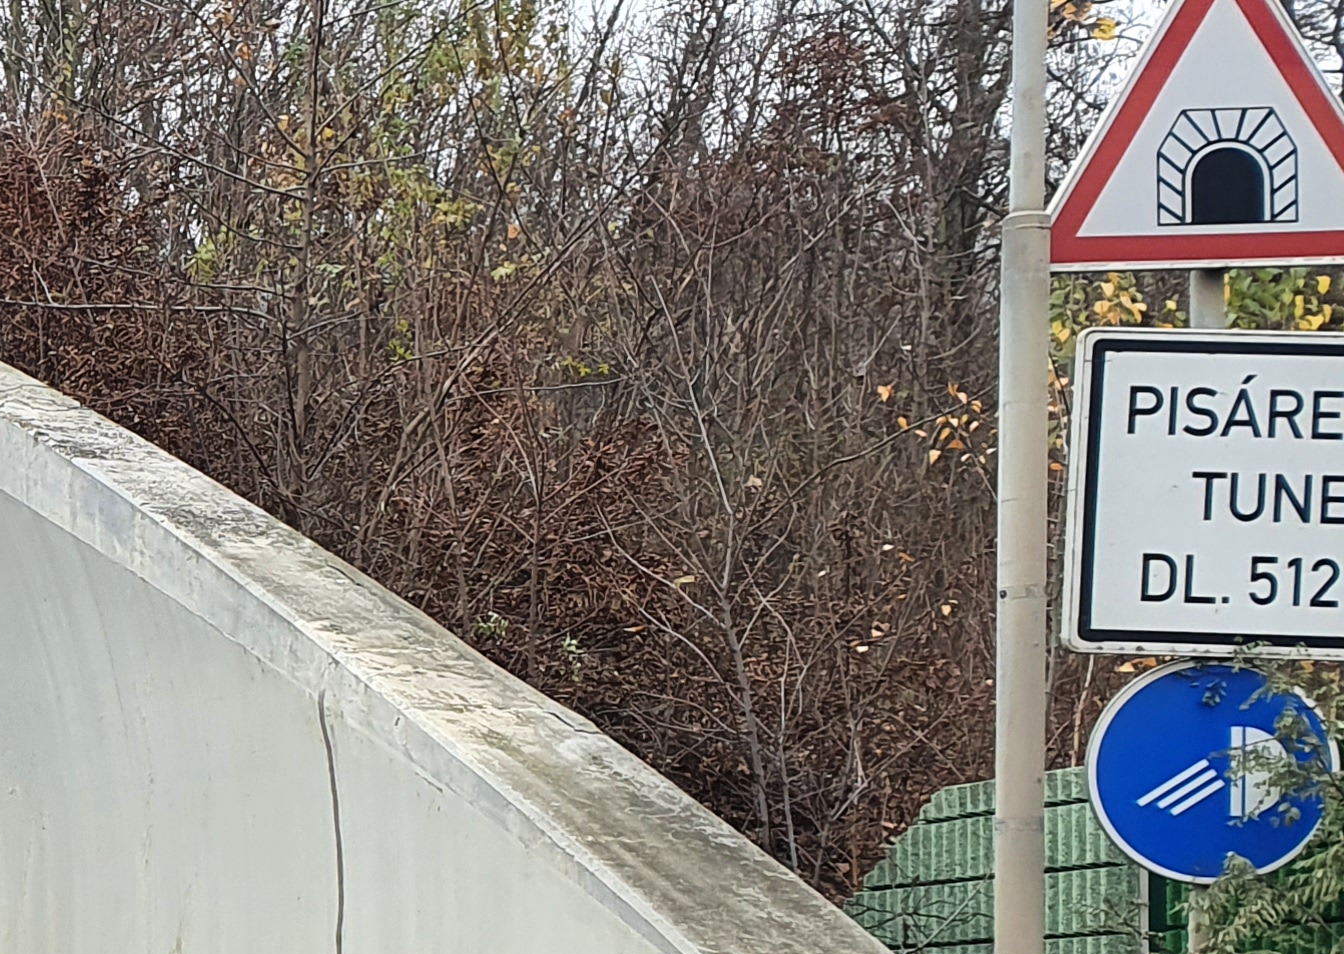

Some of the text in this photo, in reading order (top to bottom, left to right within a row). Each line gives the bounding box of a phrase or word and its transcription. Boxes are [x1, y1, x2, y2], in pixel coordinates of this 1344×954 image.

[1127, 374, 1344, 440] PISÁRE
[1192, 471, 1344, 525] TUNE
[1140, 553, 1340, 608] DL. 512
